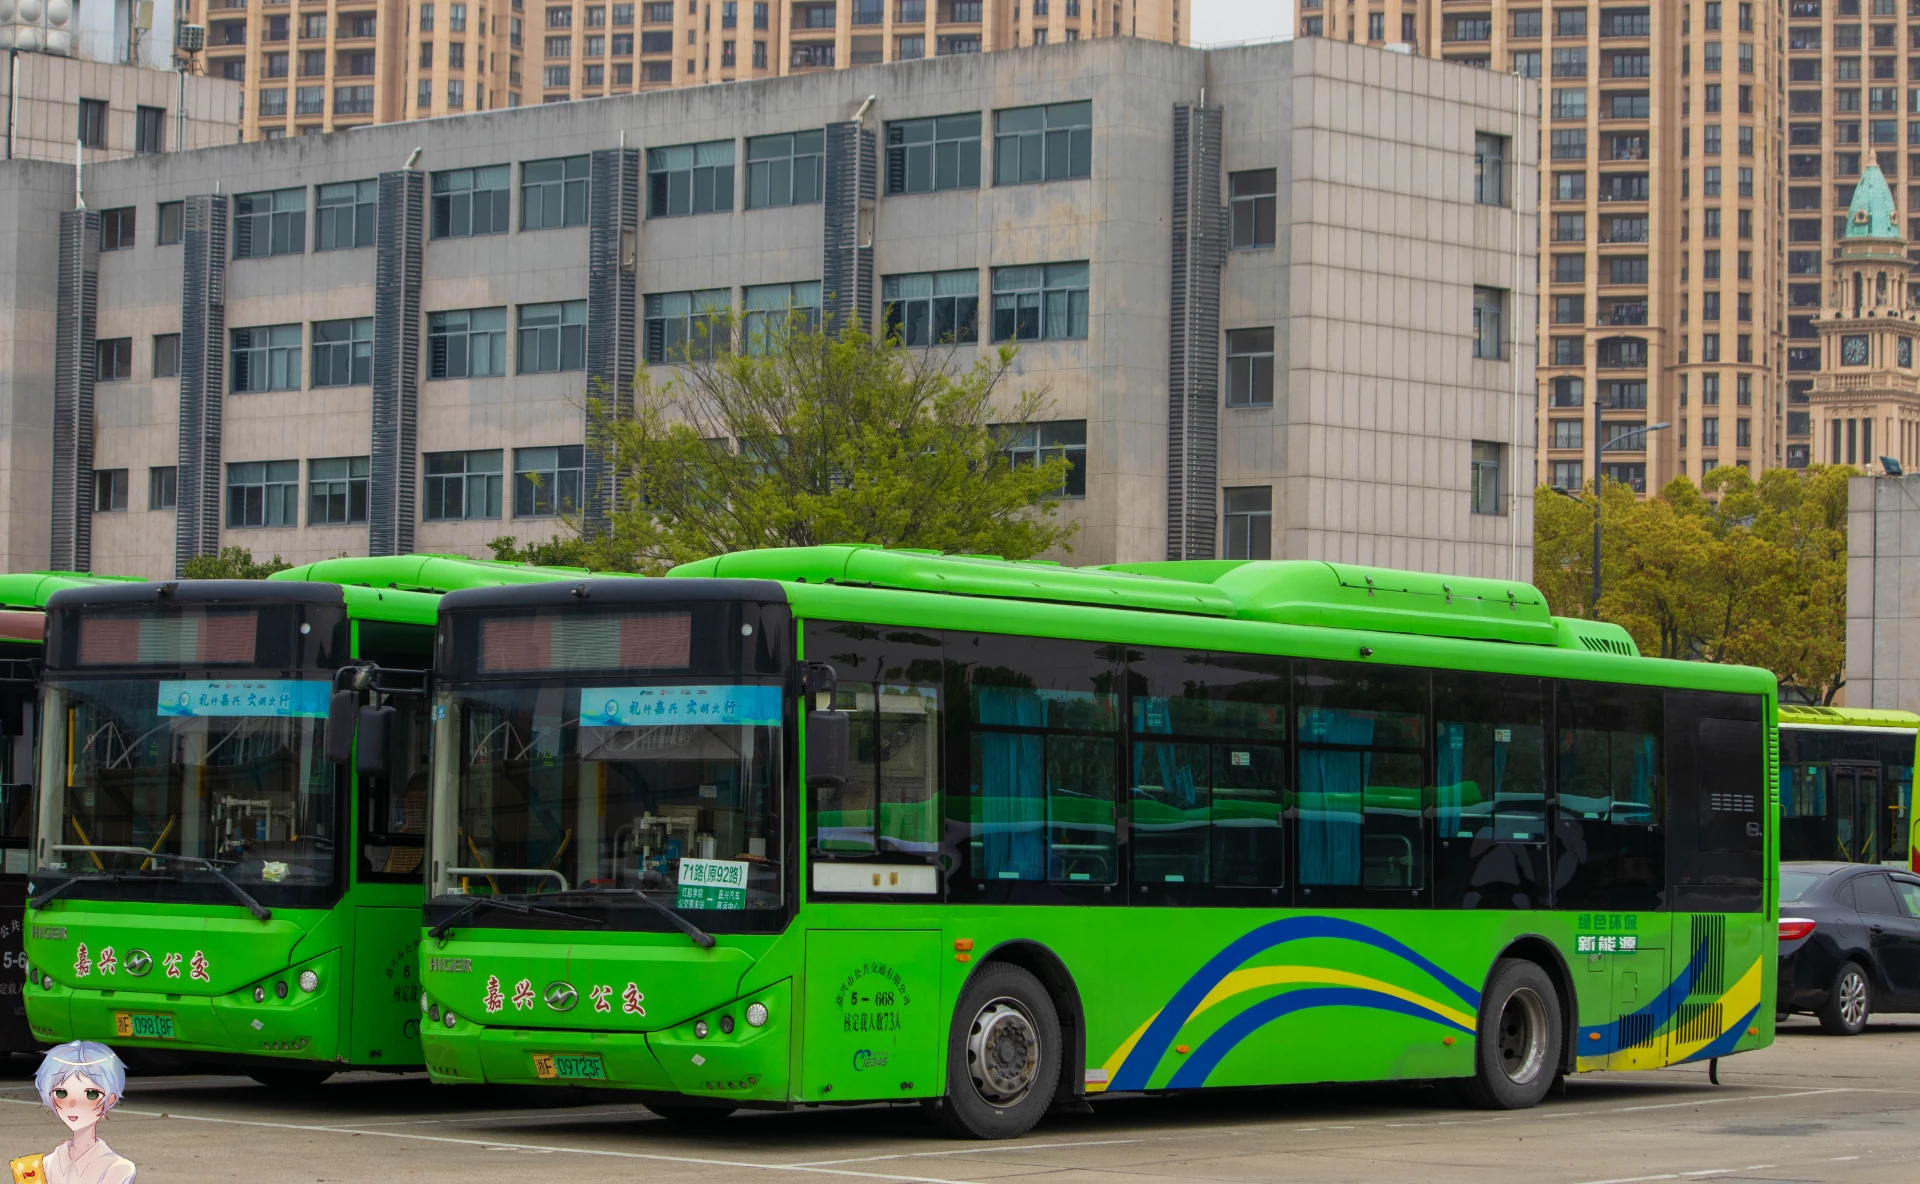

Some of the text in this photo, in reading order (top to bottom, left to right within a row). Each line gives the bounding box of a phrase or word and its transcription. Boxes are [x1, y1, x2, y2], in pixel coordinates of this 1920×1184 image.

[629, 700, 678, 715] 礼行嘉兴
[686, 700, 738, 715] 文明出行
[683, 863, 743, 886] 71路(原92路)
[1578, 914, 1637, 930] 绿色环保
[32, 926, 67, 940] HIGER
[1578, 936, 1636, 951] 新能源
[74, 942, 210, 983] 嘉兴 公交
[429, 957, 472, 973] HIGER
[483, 974, 646, 1017] 嘉兴 公交
[844, 1012, 901, 1032] 核定载人数73人
[863, 1057, 888, 1068] 12345
